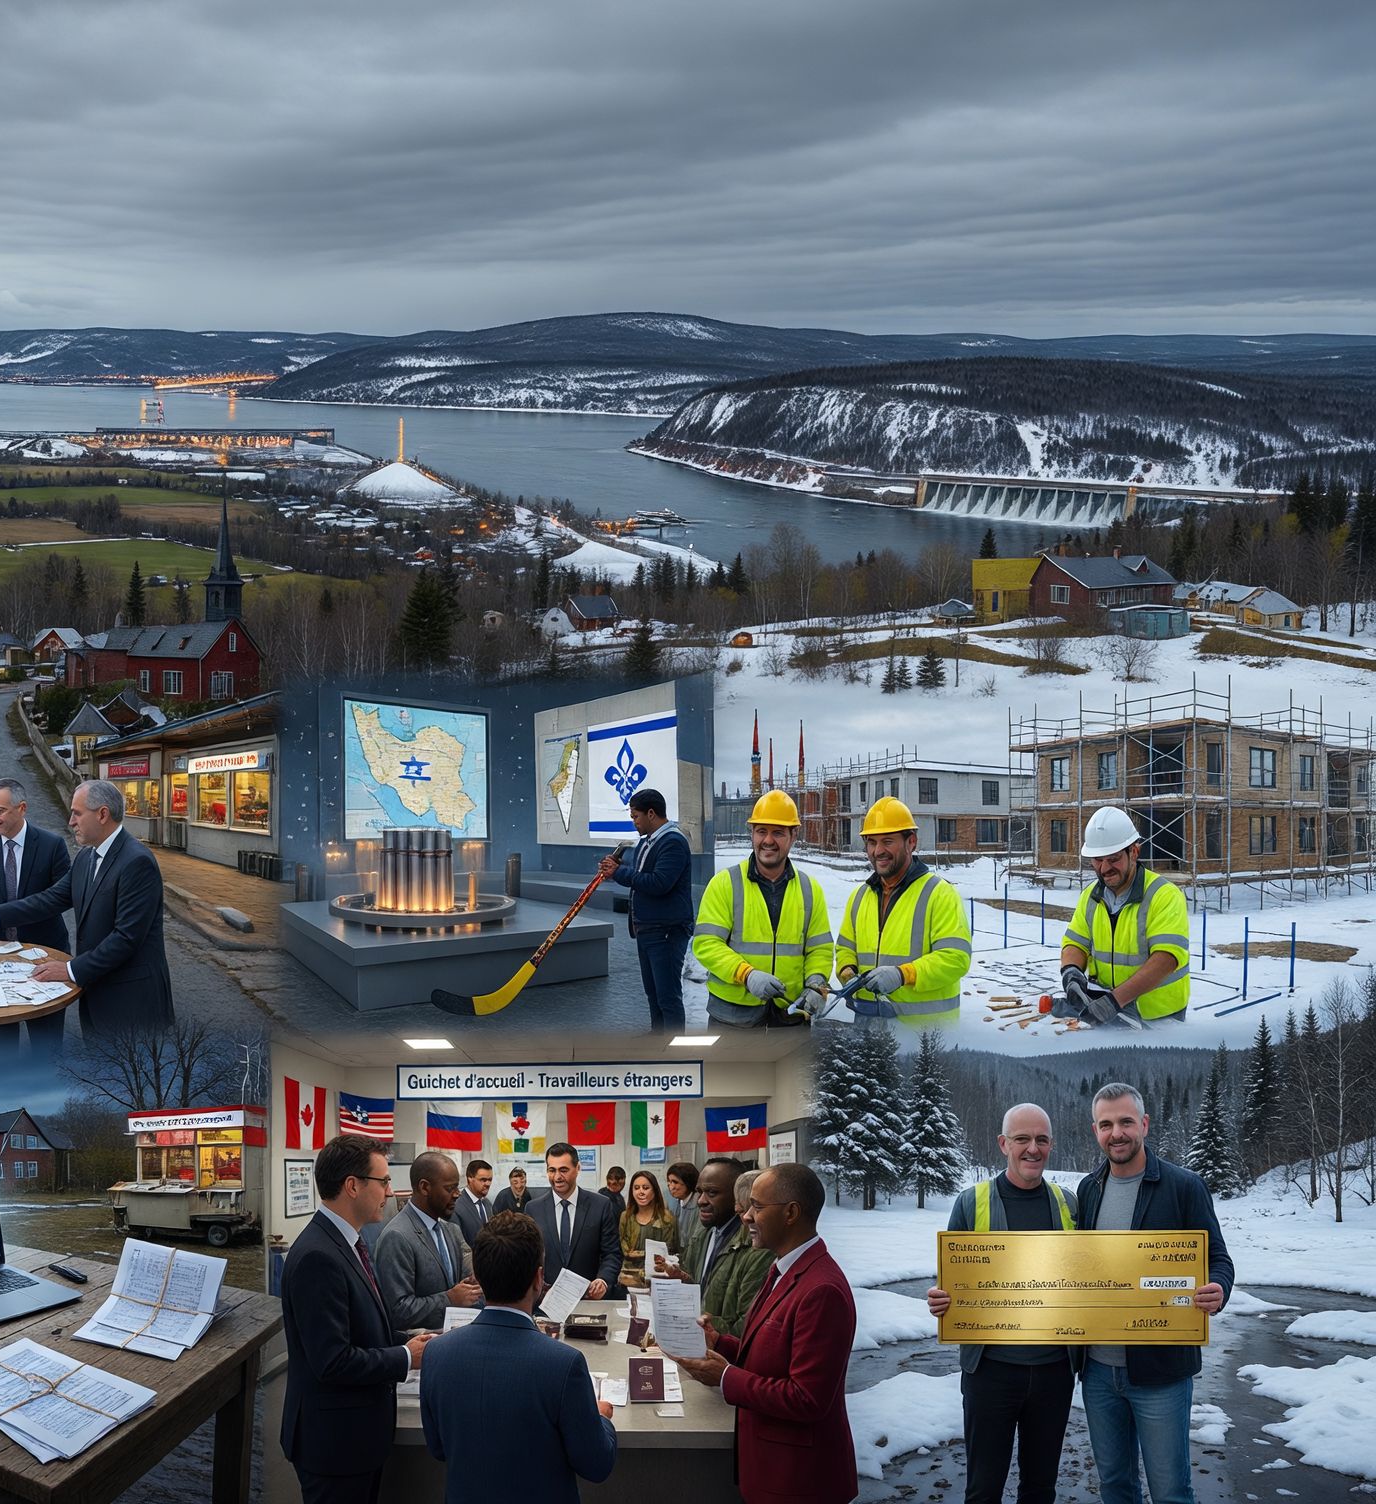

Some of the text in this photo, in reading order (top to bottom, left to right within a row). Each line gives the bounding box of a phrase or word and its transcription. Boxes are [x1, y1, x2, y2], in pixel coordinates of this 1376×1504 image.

[407, 1073, 461, 1089] Guichet
[464, 1072, 525, 1089] d'accueil
[537, 1071, 620, 1088] Travailleurs
[623, 1072, 693, 1091] étrangers
